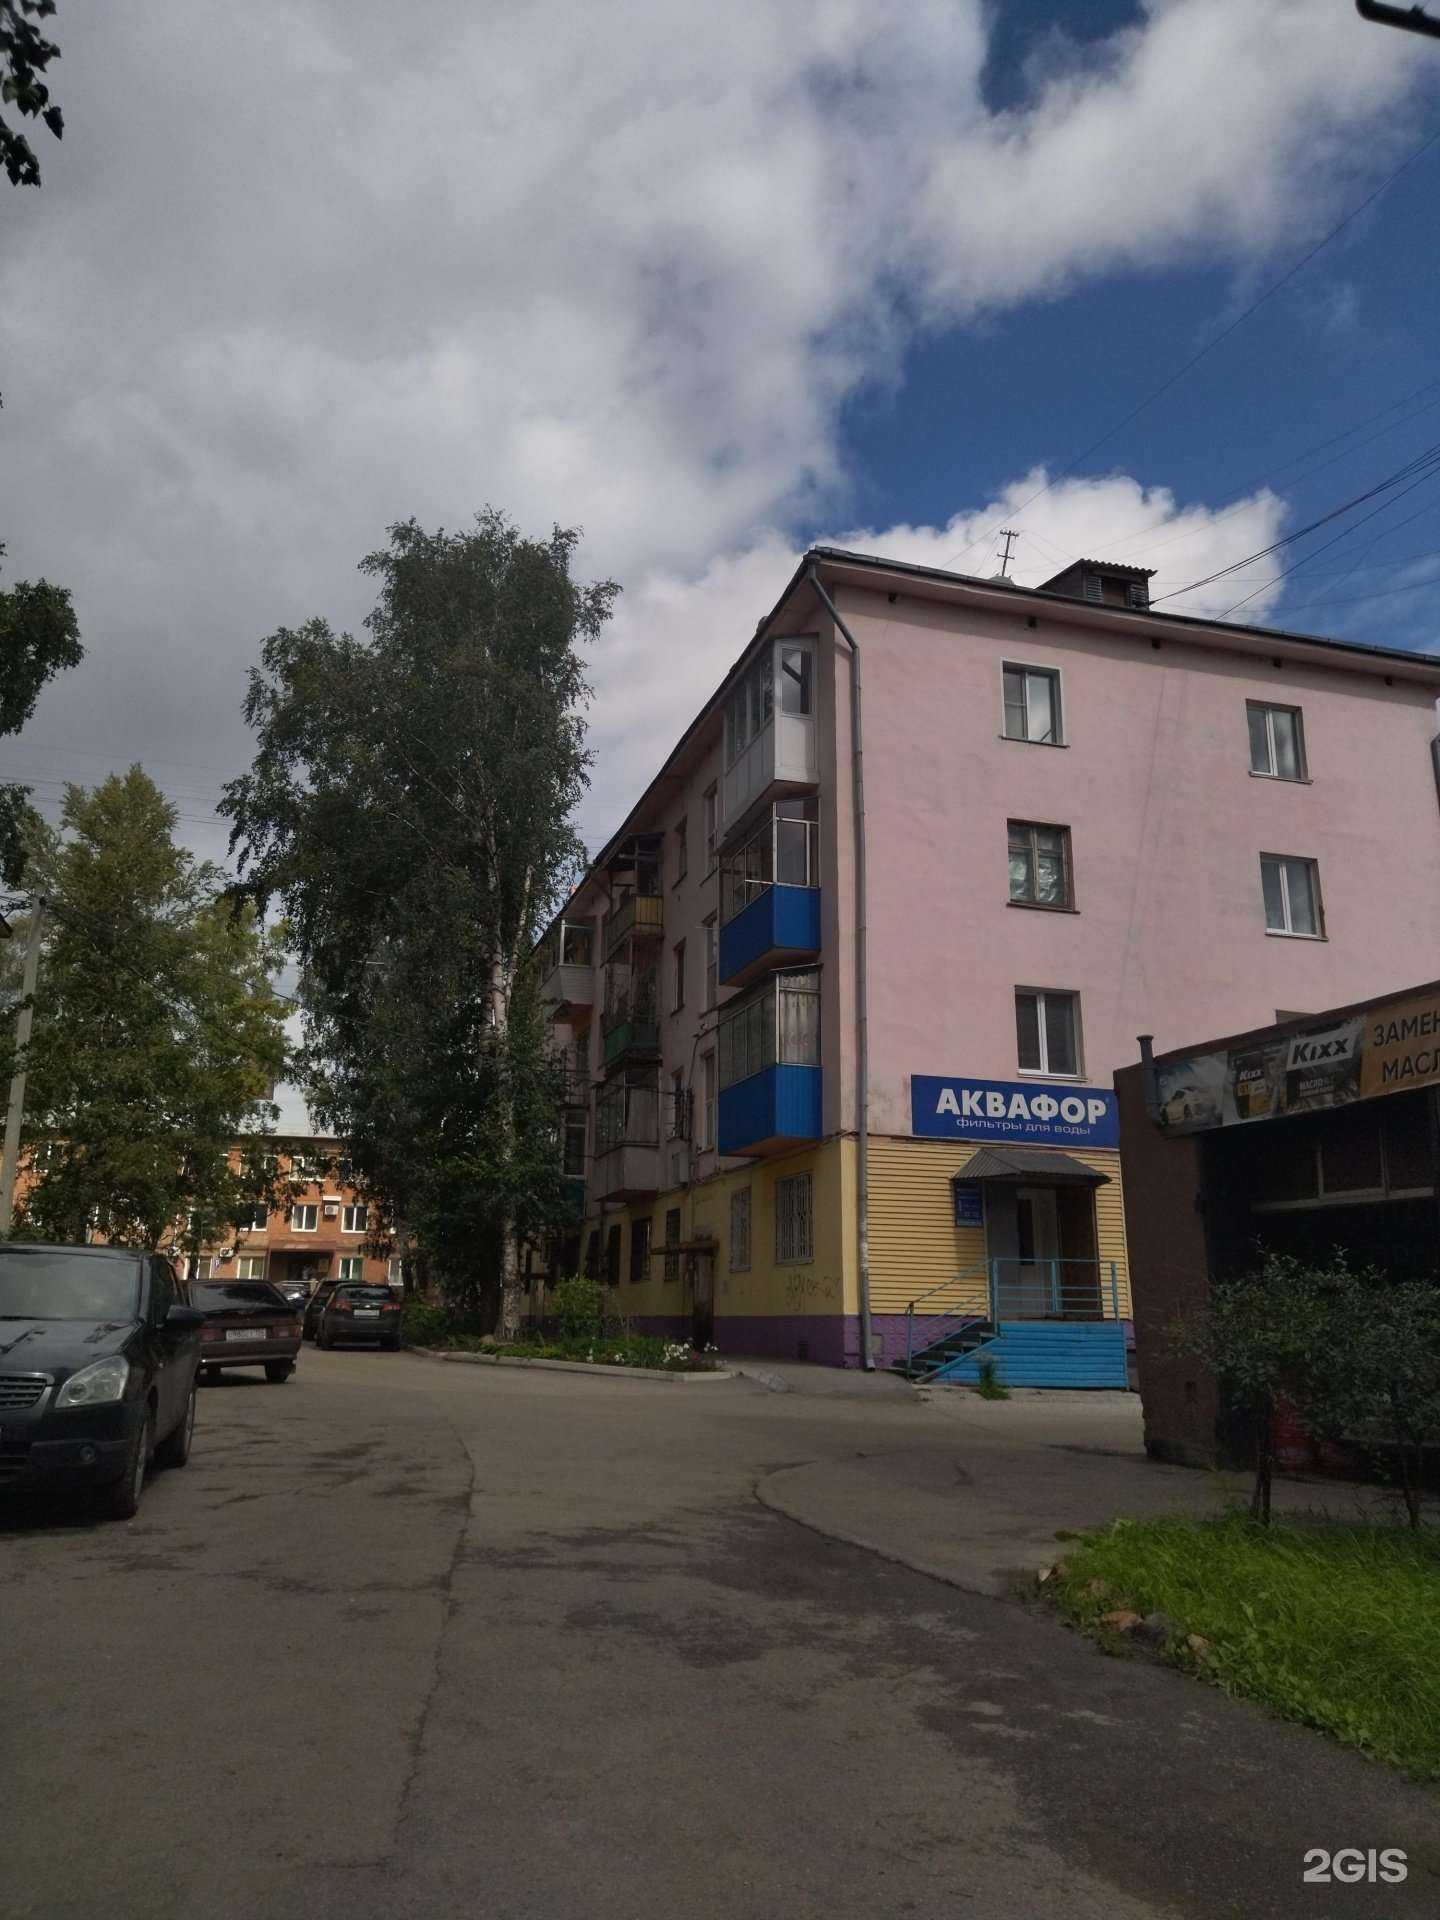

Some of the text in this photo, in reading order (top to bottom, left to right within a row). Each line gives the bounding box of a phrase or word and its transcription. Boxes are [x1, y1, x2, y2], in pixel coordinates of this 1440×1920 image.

[1292, 1039, 1349, 1065] Kixx
[935, 1088, 1107, 1125] АКВАФОР
[956, 1118, 1090, 1136] фильтры для воды
